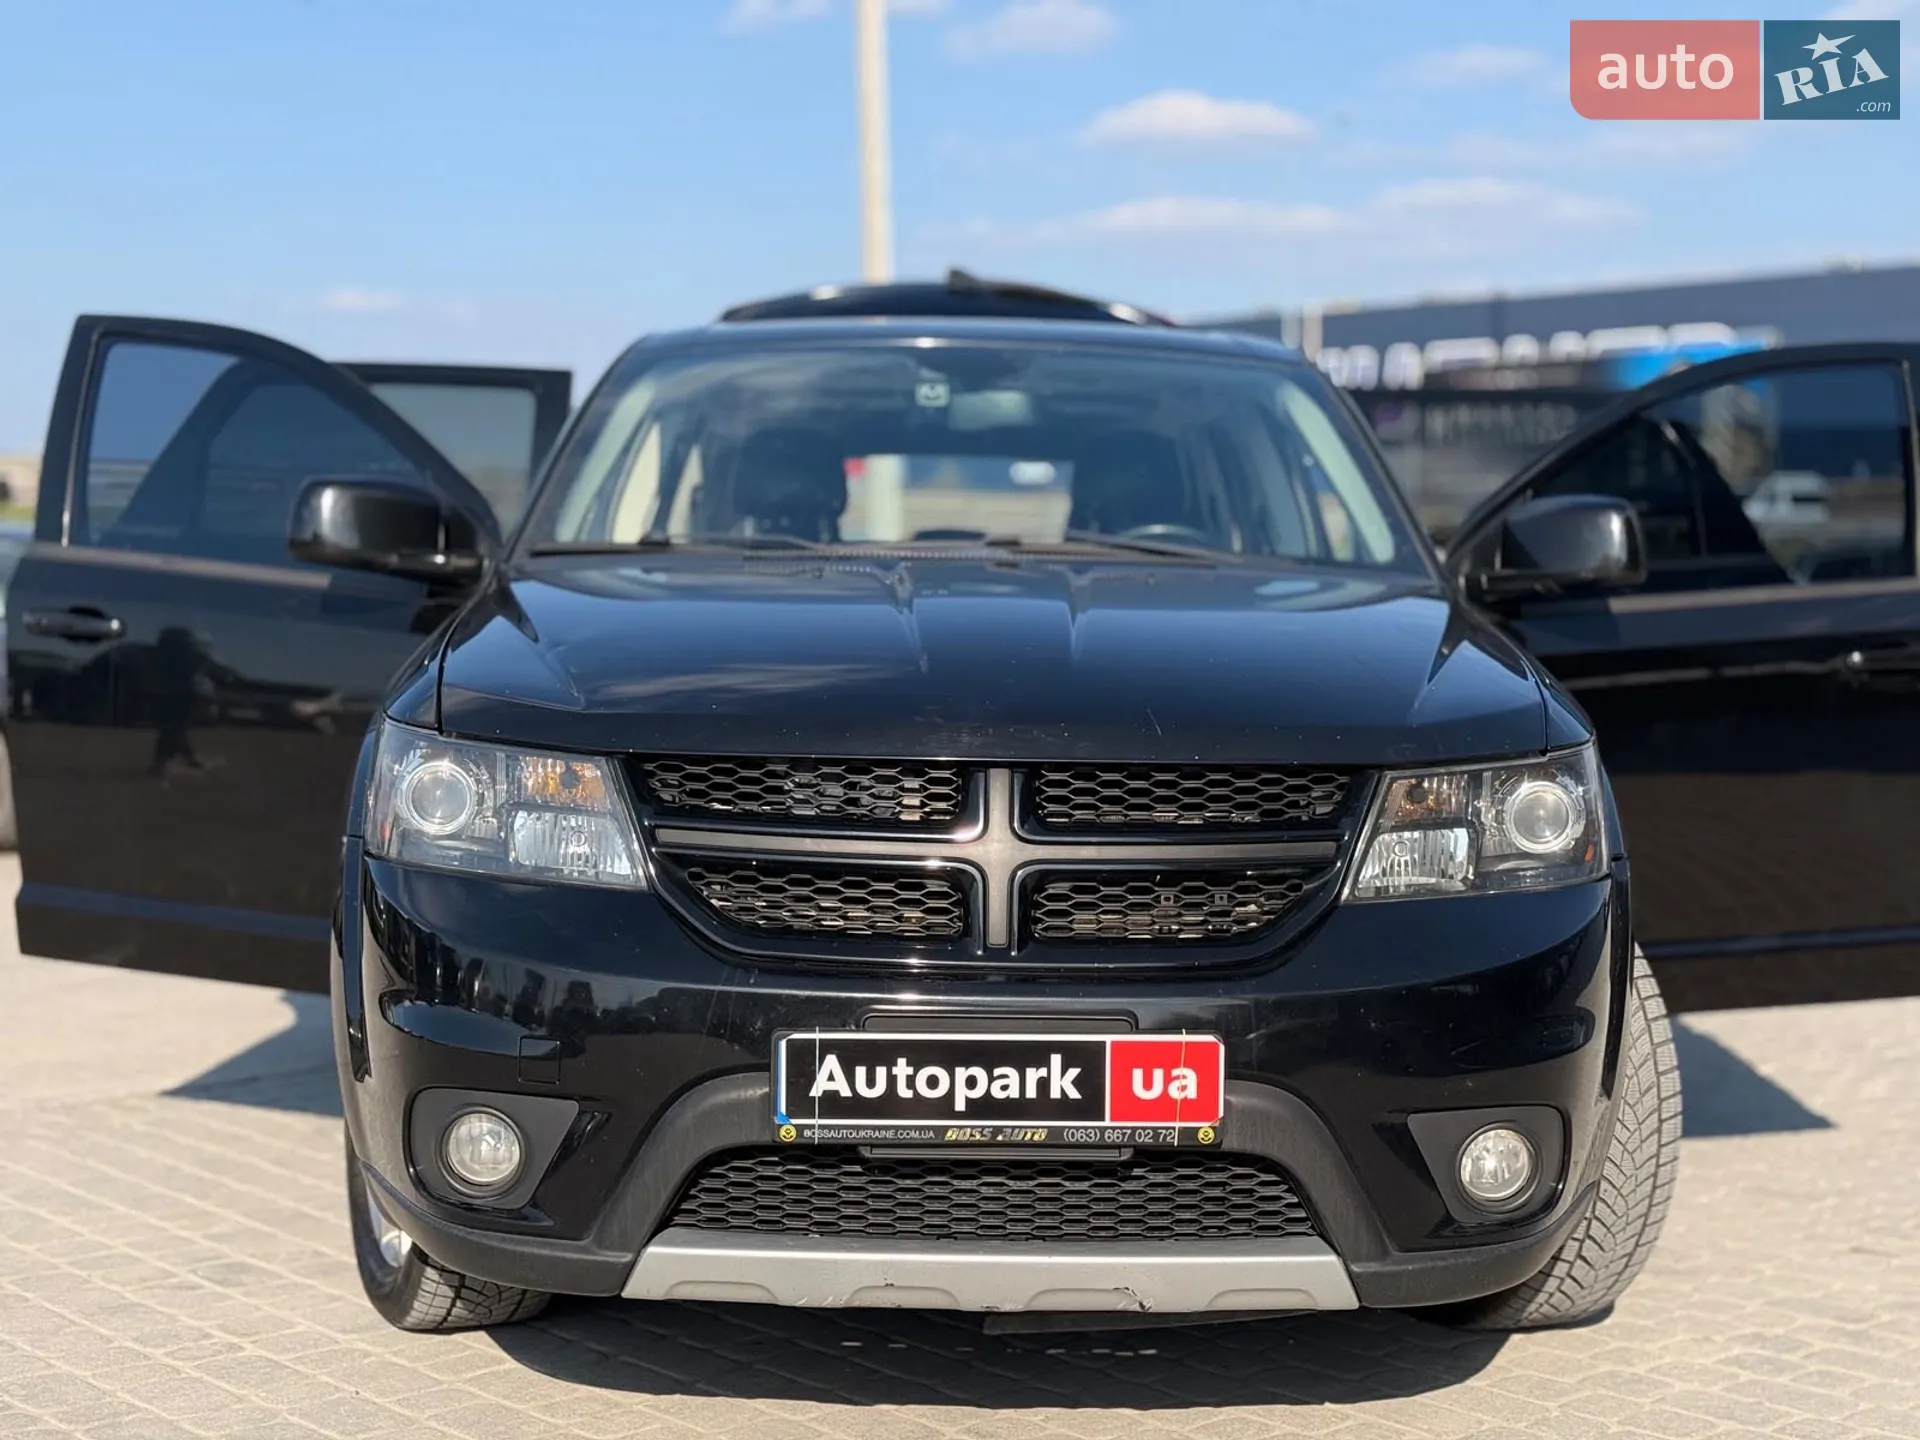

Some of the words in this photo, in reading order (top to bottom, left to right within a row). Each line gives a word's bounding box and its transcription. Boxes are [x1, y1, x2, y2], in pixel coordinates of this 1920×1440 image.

[808, 1053, 1082, 1111] Autopark
[1132, 1066, 1198, 1101] ua
[803, 1128, 935, 1139] BOSSAUTOUKRAINE.COM.UA
[944, 1127, 993, 1142] BOSS
[996, 1128, 1048, 1142] AUTO
[1063, 1128, 1100, 1143] (063)
[1104, 1129, 1132, 1142] 667
[1135, 1129, 1153, 1142] 02
[1157, 1129, 1175, 1142] 72
